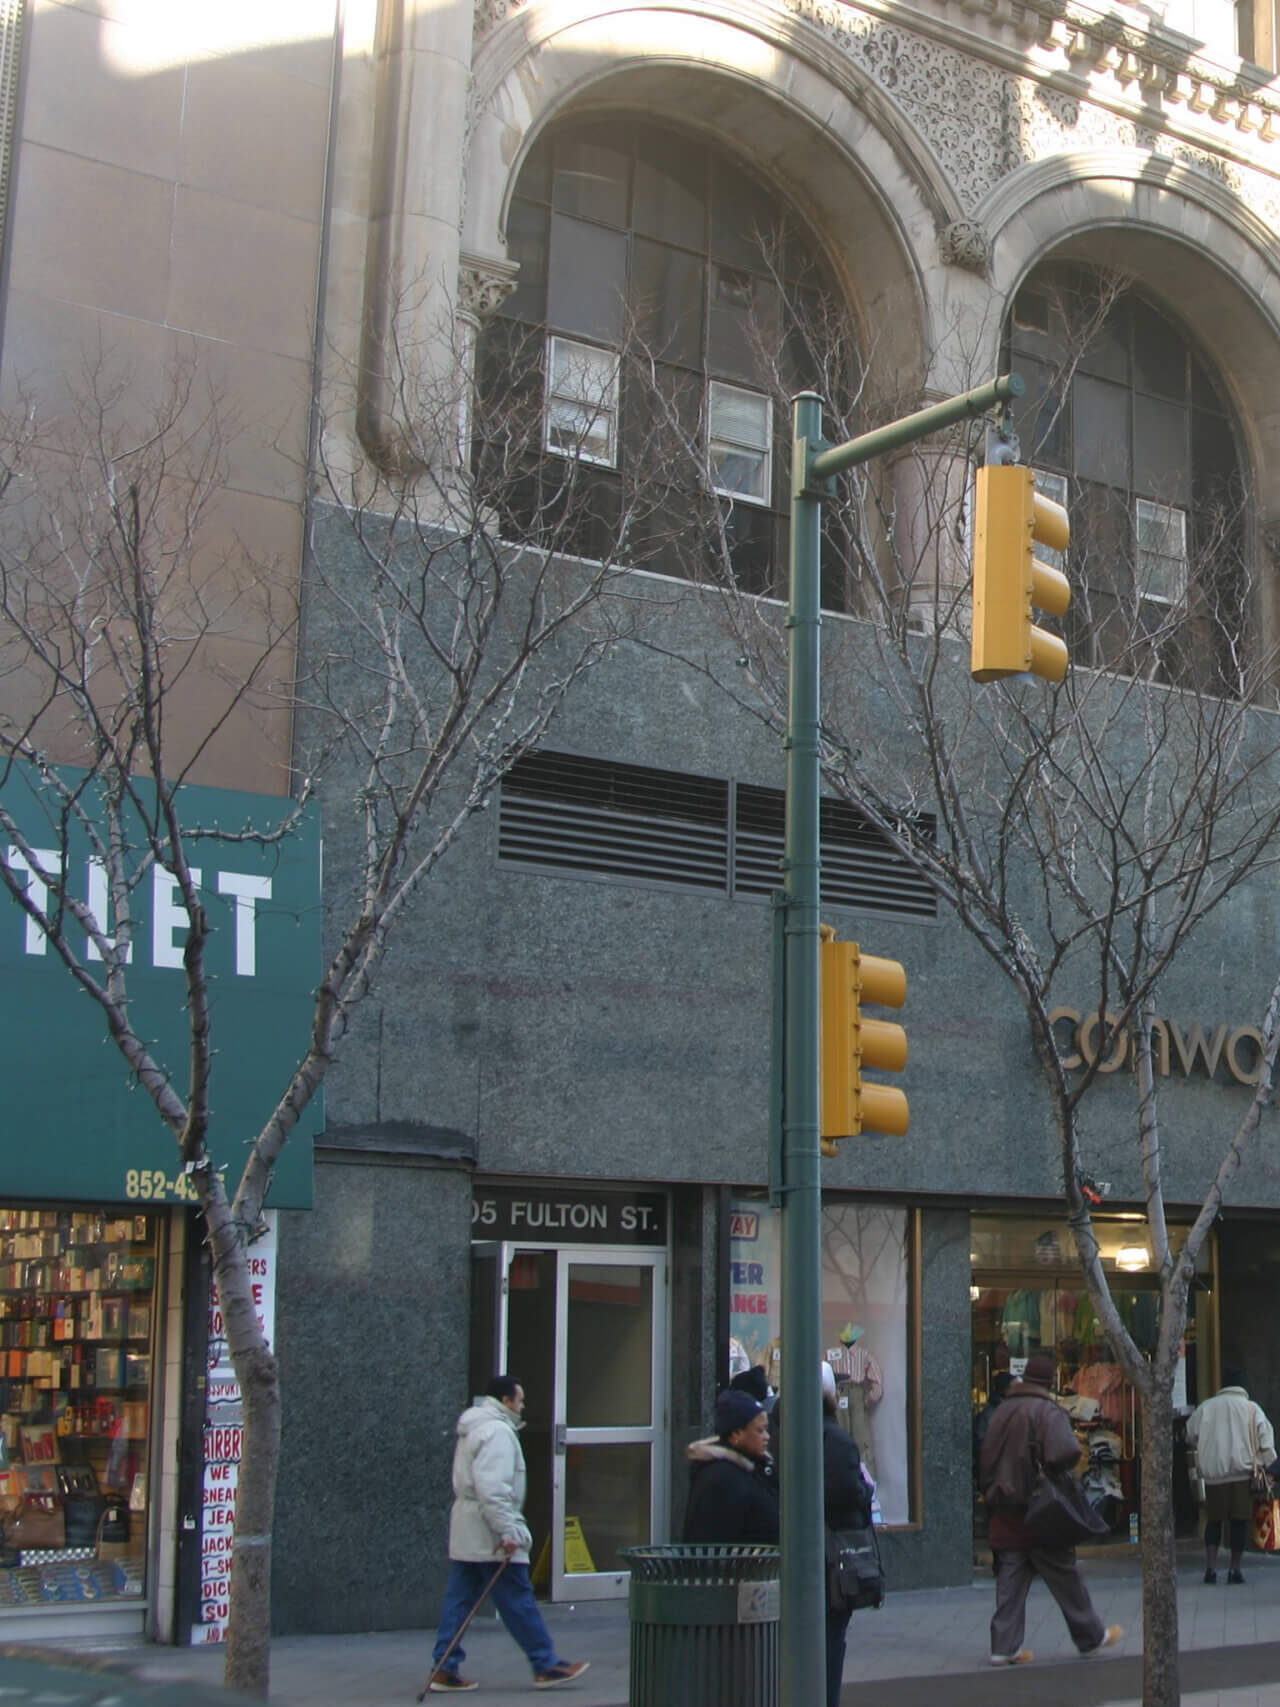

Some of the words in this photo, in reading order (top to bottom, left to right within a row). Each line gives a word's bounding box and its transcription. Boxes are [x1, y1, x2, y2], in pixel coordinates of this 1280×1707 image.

[511, 1201, 608, 1228] FULTON
[620, 1207, 659, 1231] ST.
[730, 1215, 755, 1235] AY
[730, 1263, 763, 1285] ER
[730, 1294, 768, 1314] NCE
[210, 1466, 230, 1481] WE
[208, 1510, 235, 1526] JEA
[201, 1536, 233, 1554] JACK
[203, 1558, 233, 1577] T-SH
